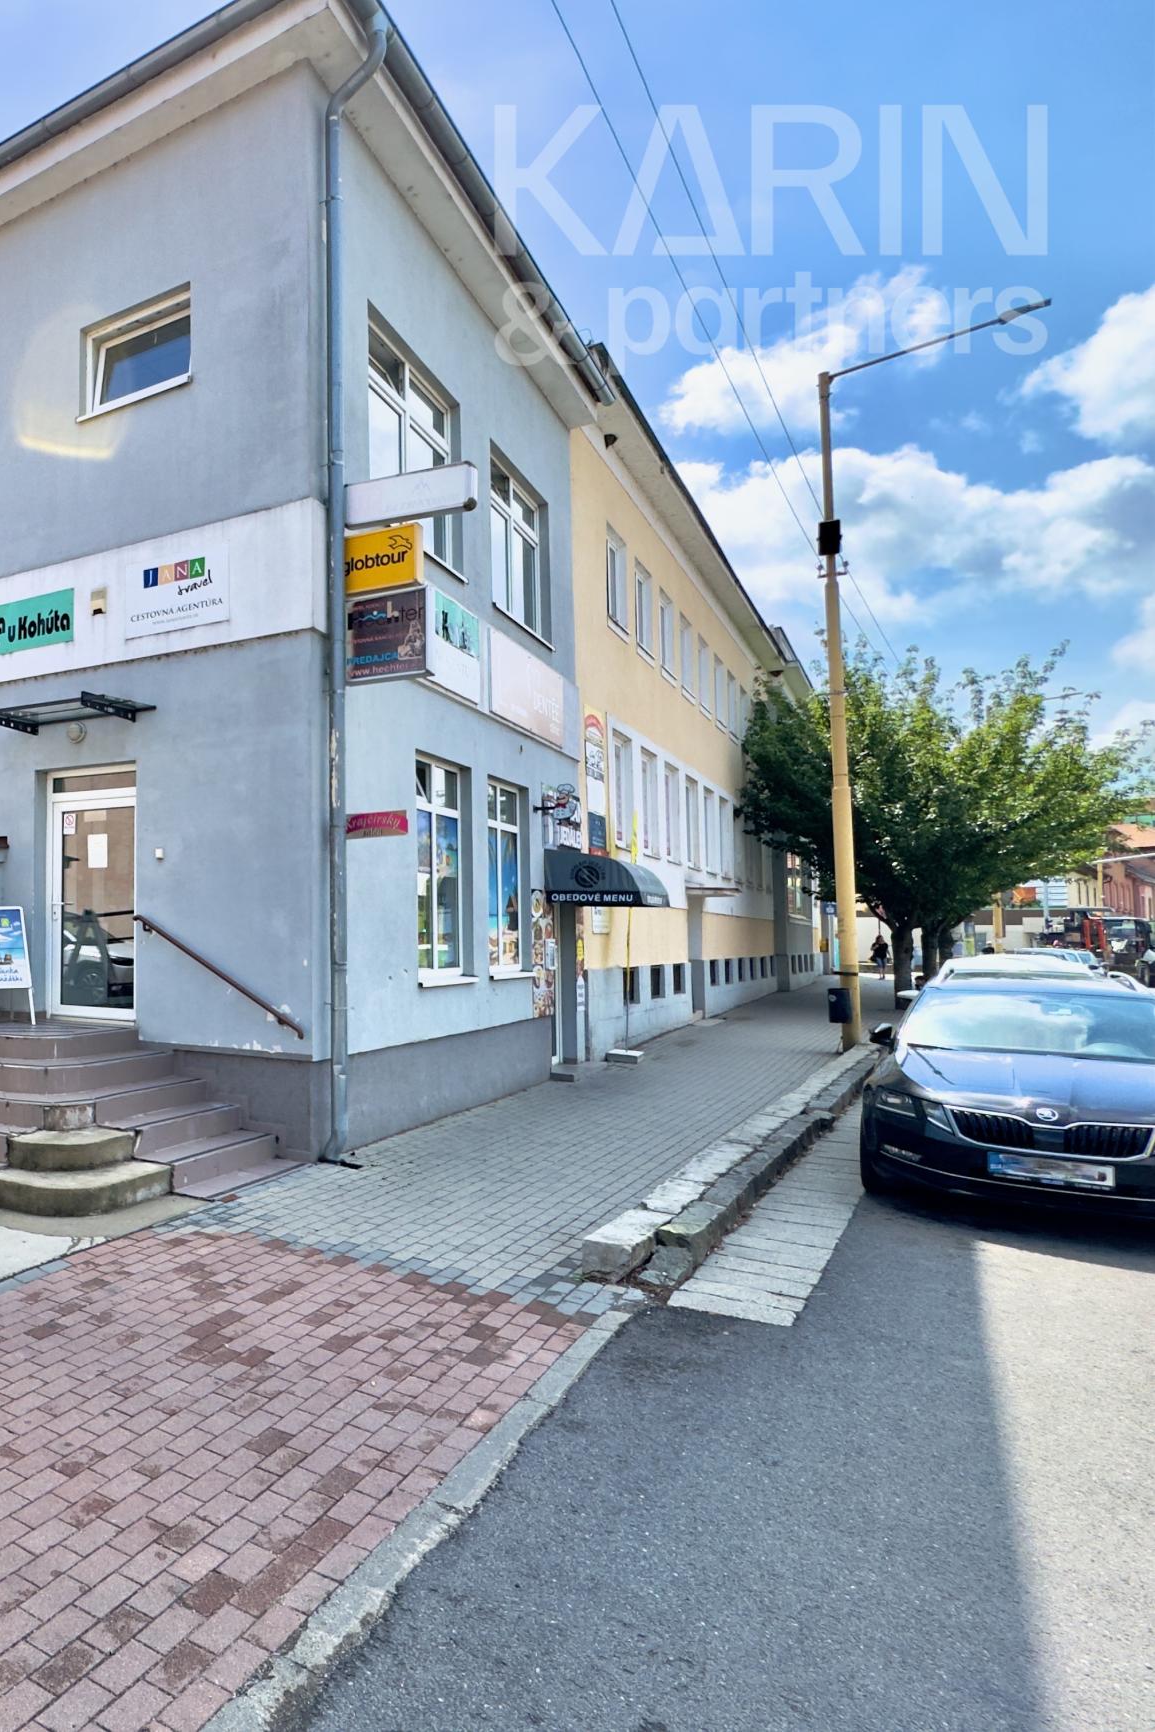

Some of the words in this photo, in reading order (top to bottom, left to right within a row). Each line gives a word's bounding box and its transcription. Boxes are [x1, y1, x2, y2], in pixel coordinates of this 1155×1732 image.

[145, 559, 204, 587] JANA
[344, 550, 408, 577] globtour
[177, 569, 213, 595] travel
[7, 625, 16, 643] u
[17, 609, 71, 640] Kohúta
[551, 893, 601, 902] OBEDOVÉ
[603, 894, 634, 902] MENU
